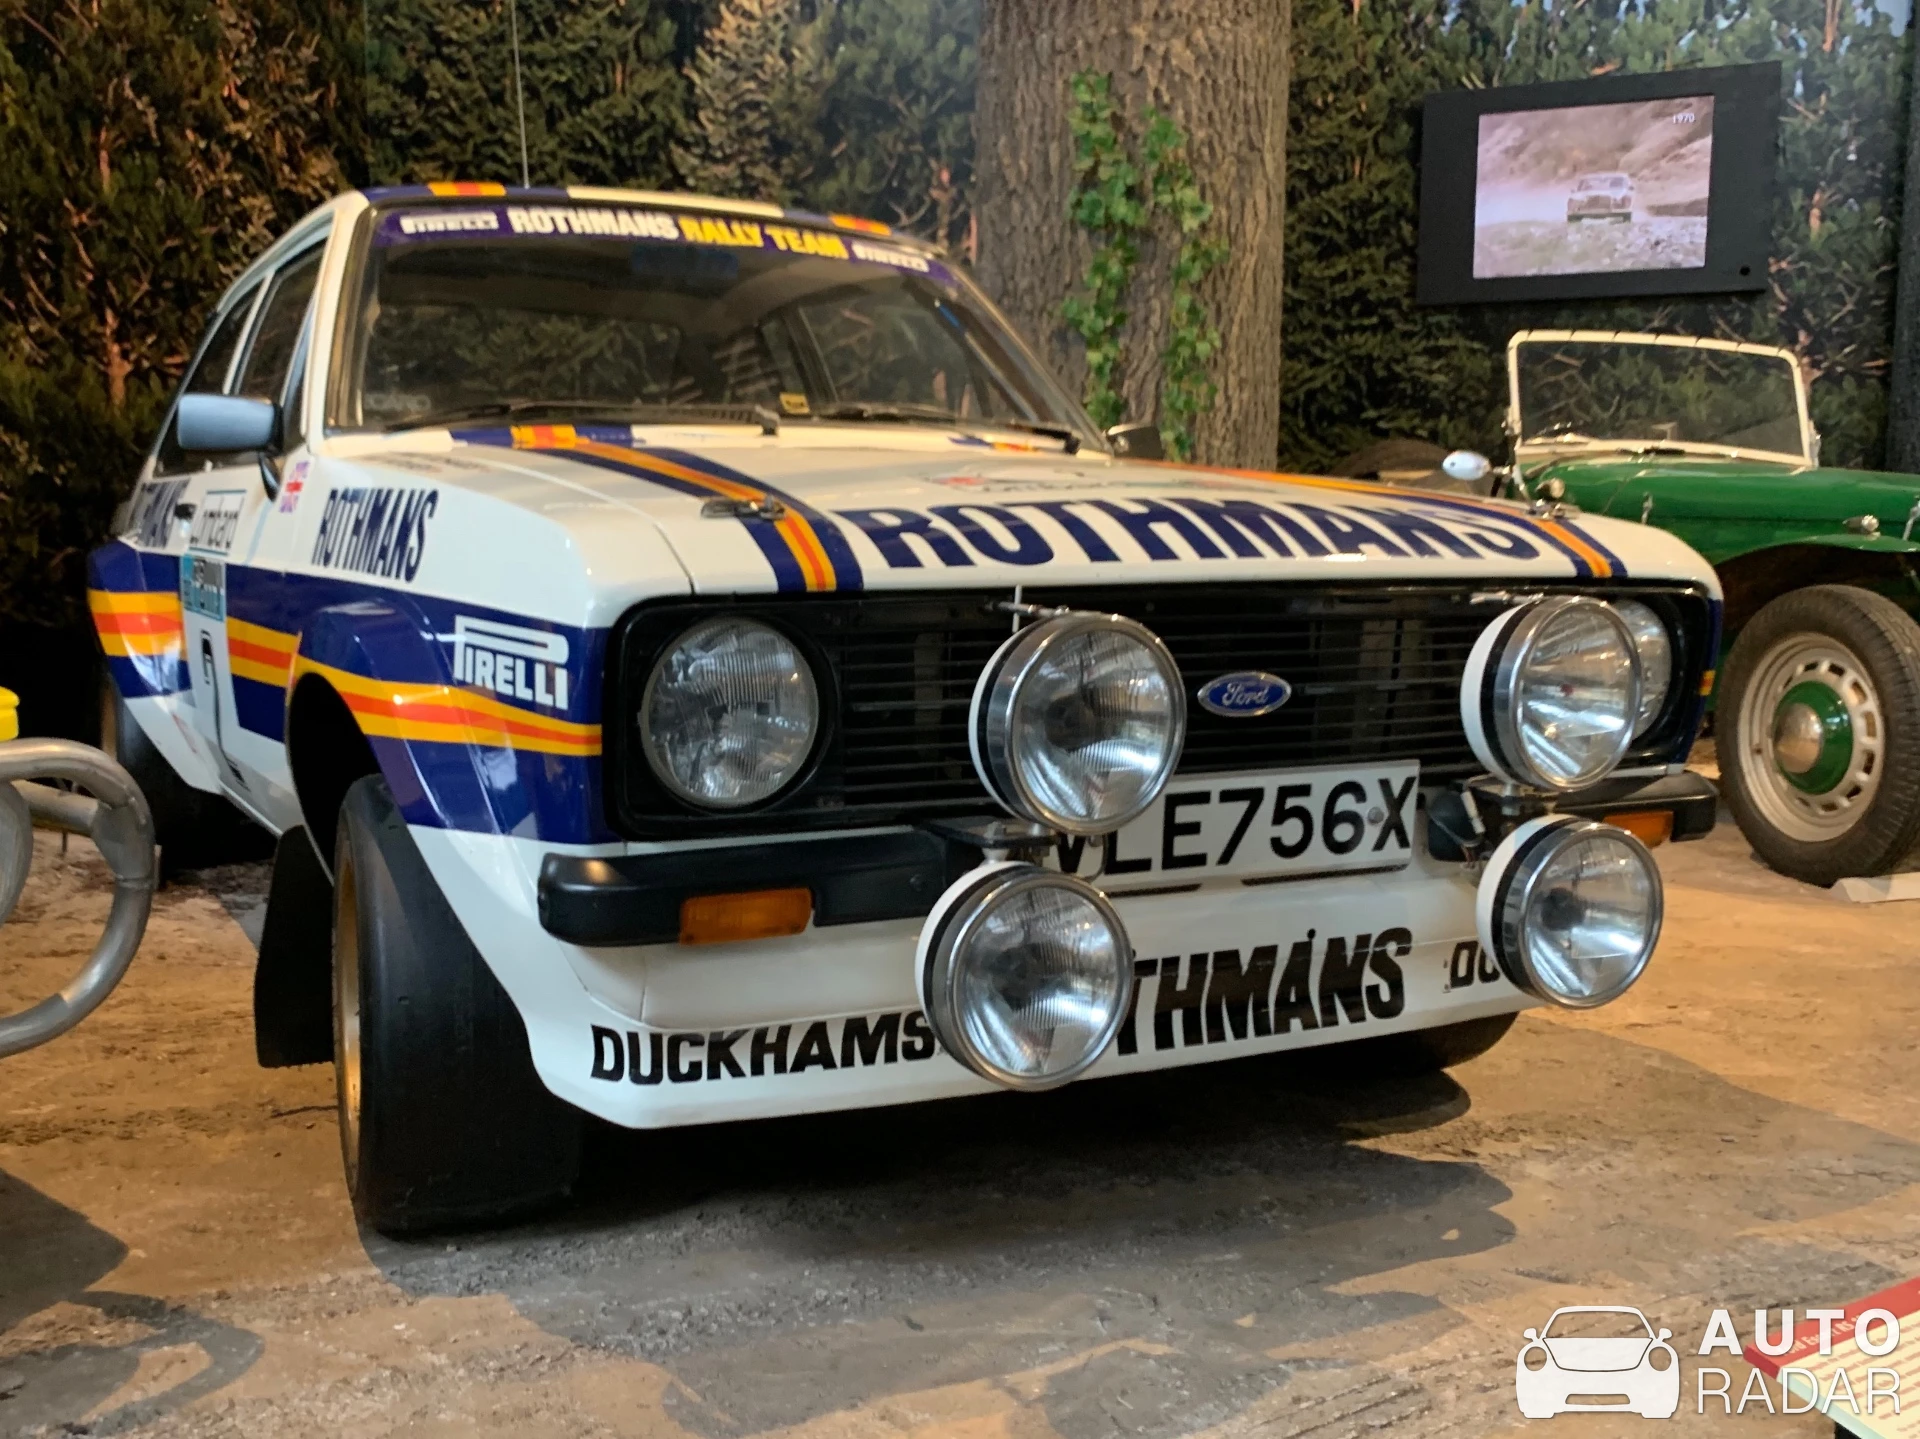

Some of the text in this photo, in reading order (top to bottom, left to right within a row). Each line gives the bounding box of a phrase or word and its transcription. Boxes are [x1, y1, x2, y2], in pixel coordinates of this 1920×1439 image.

[507, 206, 679, 240] ROTHMANS
[678, 216, 764, 247] RALLY
[764, 225, 849, 260] TEAM
[311, 486, 440, 584] ROTHMANS
[835, 498, 1541, 567] ROTHMANS
[454, 614, 569, 710] PIRELLI
[1221, 682, 1270, 706] Ford
[1117, 927, 1414, 1057] THMANS
[590, 1010, 935, 1086] DUCKHAMS
